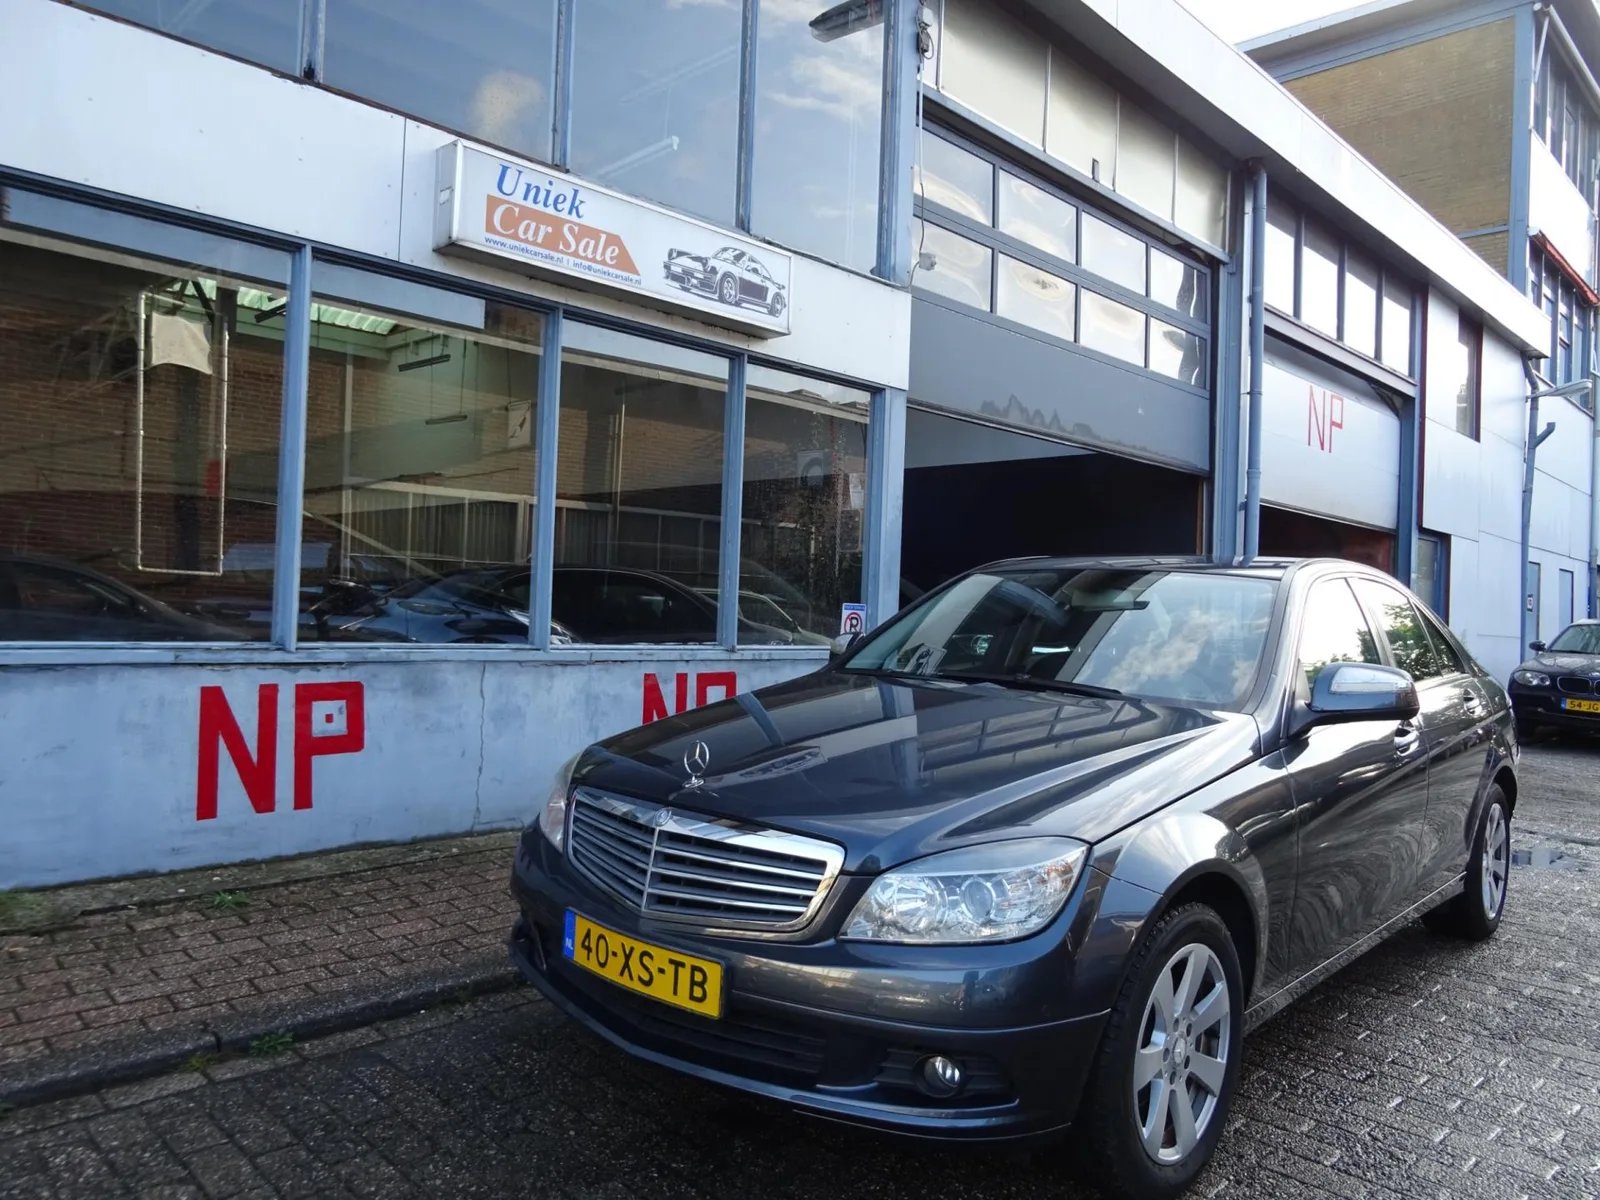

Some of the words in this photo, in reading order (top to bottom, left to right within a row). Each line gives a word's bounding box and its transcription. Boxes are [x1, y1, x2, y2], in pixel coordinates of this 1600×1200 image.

[497, 163, 586, 219] Uniek
[484, 236, 564, 264] www.uniekcarsale.nl
[572, 260, 642, 286] info@uniekcarsale.nl
[493, 204, 553, 244] Car
[559, 223, 619, 265] Sale
[1308, 385, 1344, 453] NP
[196, 681, 365, 821] NP
[581, 927, 708, 1004] 40-XS-TB
